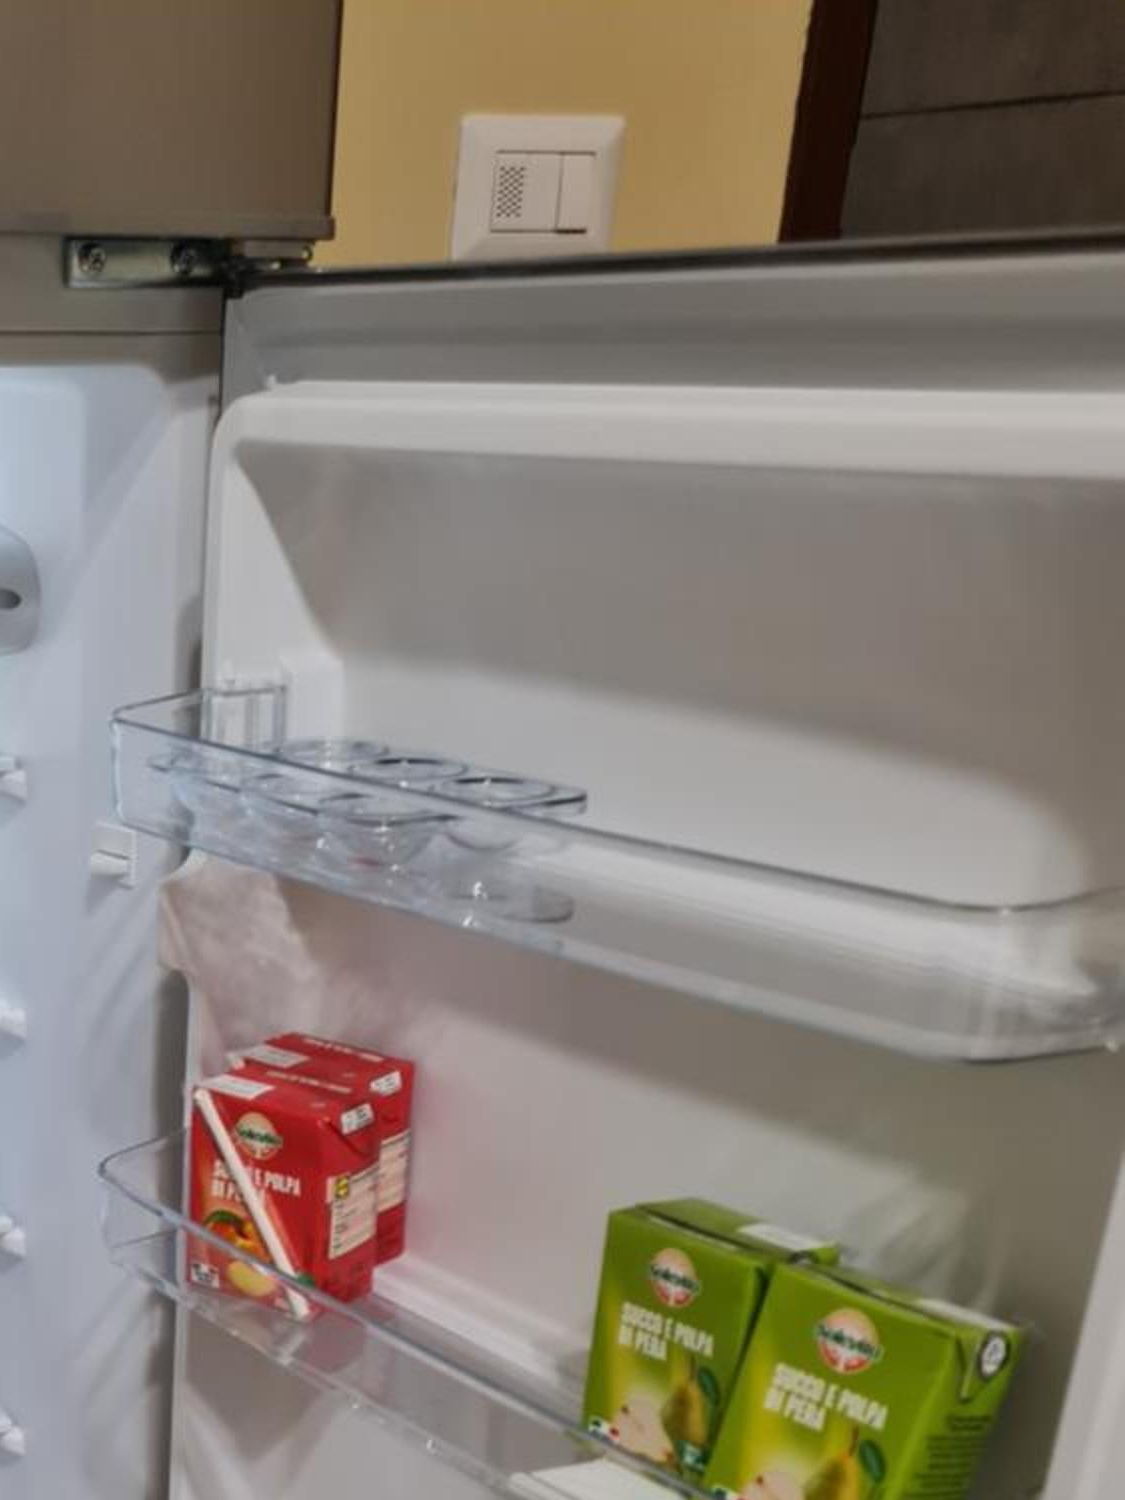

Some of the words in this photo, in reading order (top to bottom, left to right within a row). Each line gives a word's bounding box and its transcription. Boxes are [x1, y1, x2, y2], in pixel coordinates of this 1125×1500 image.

[262, 1170, 301, 1196] POLPA
[620, 1301, 663, 1336] SUCCO
[673, 1321, 715, 1358] POLPA
[774, 1363, 825, 1403] SUCCO
[836, 1387, 889, 1431] POLPA
[783, 1391, 827, 1431] PERA
